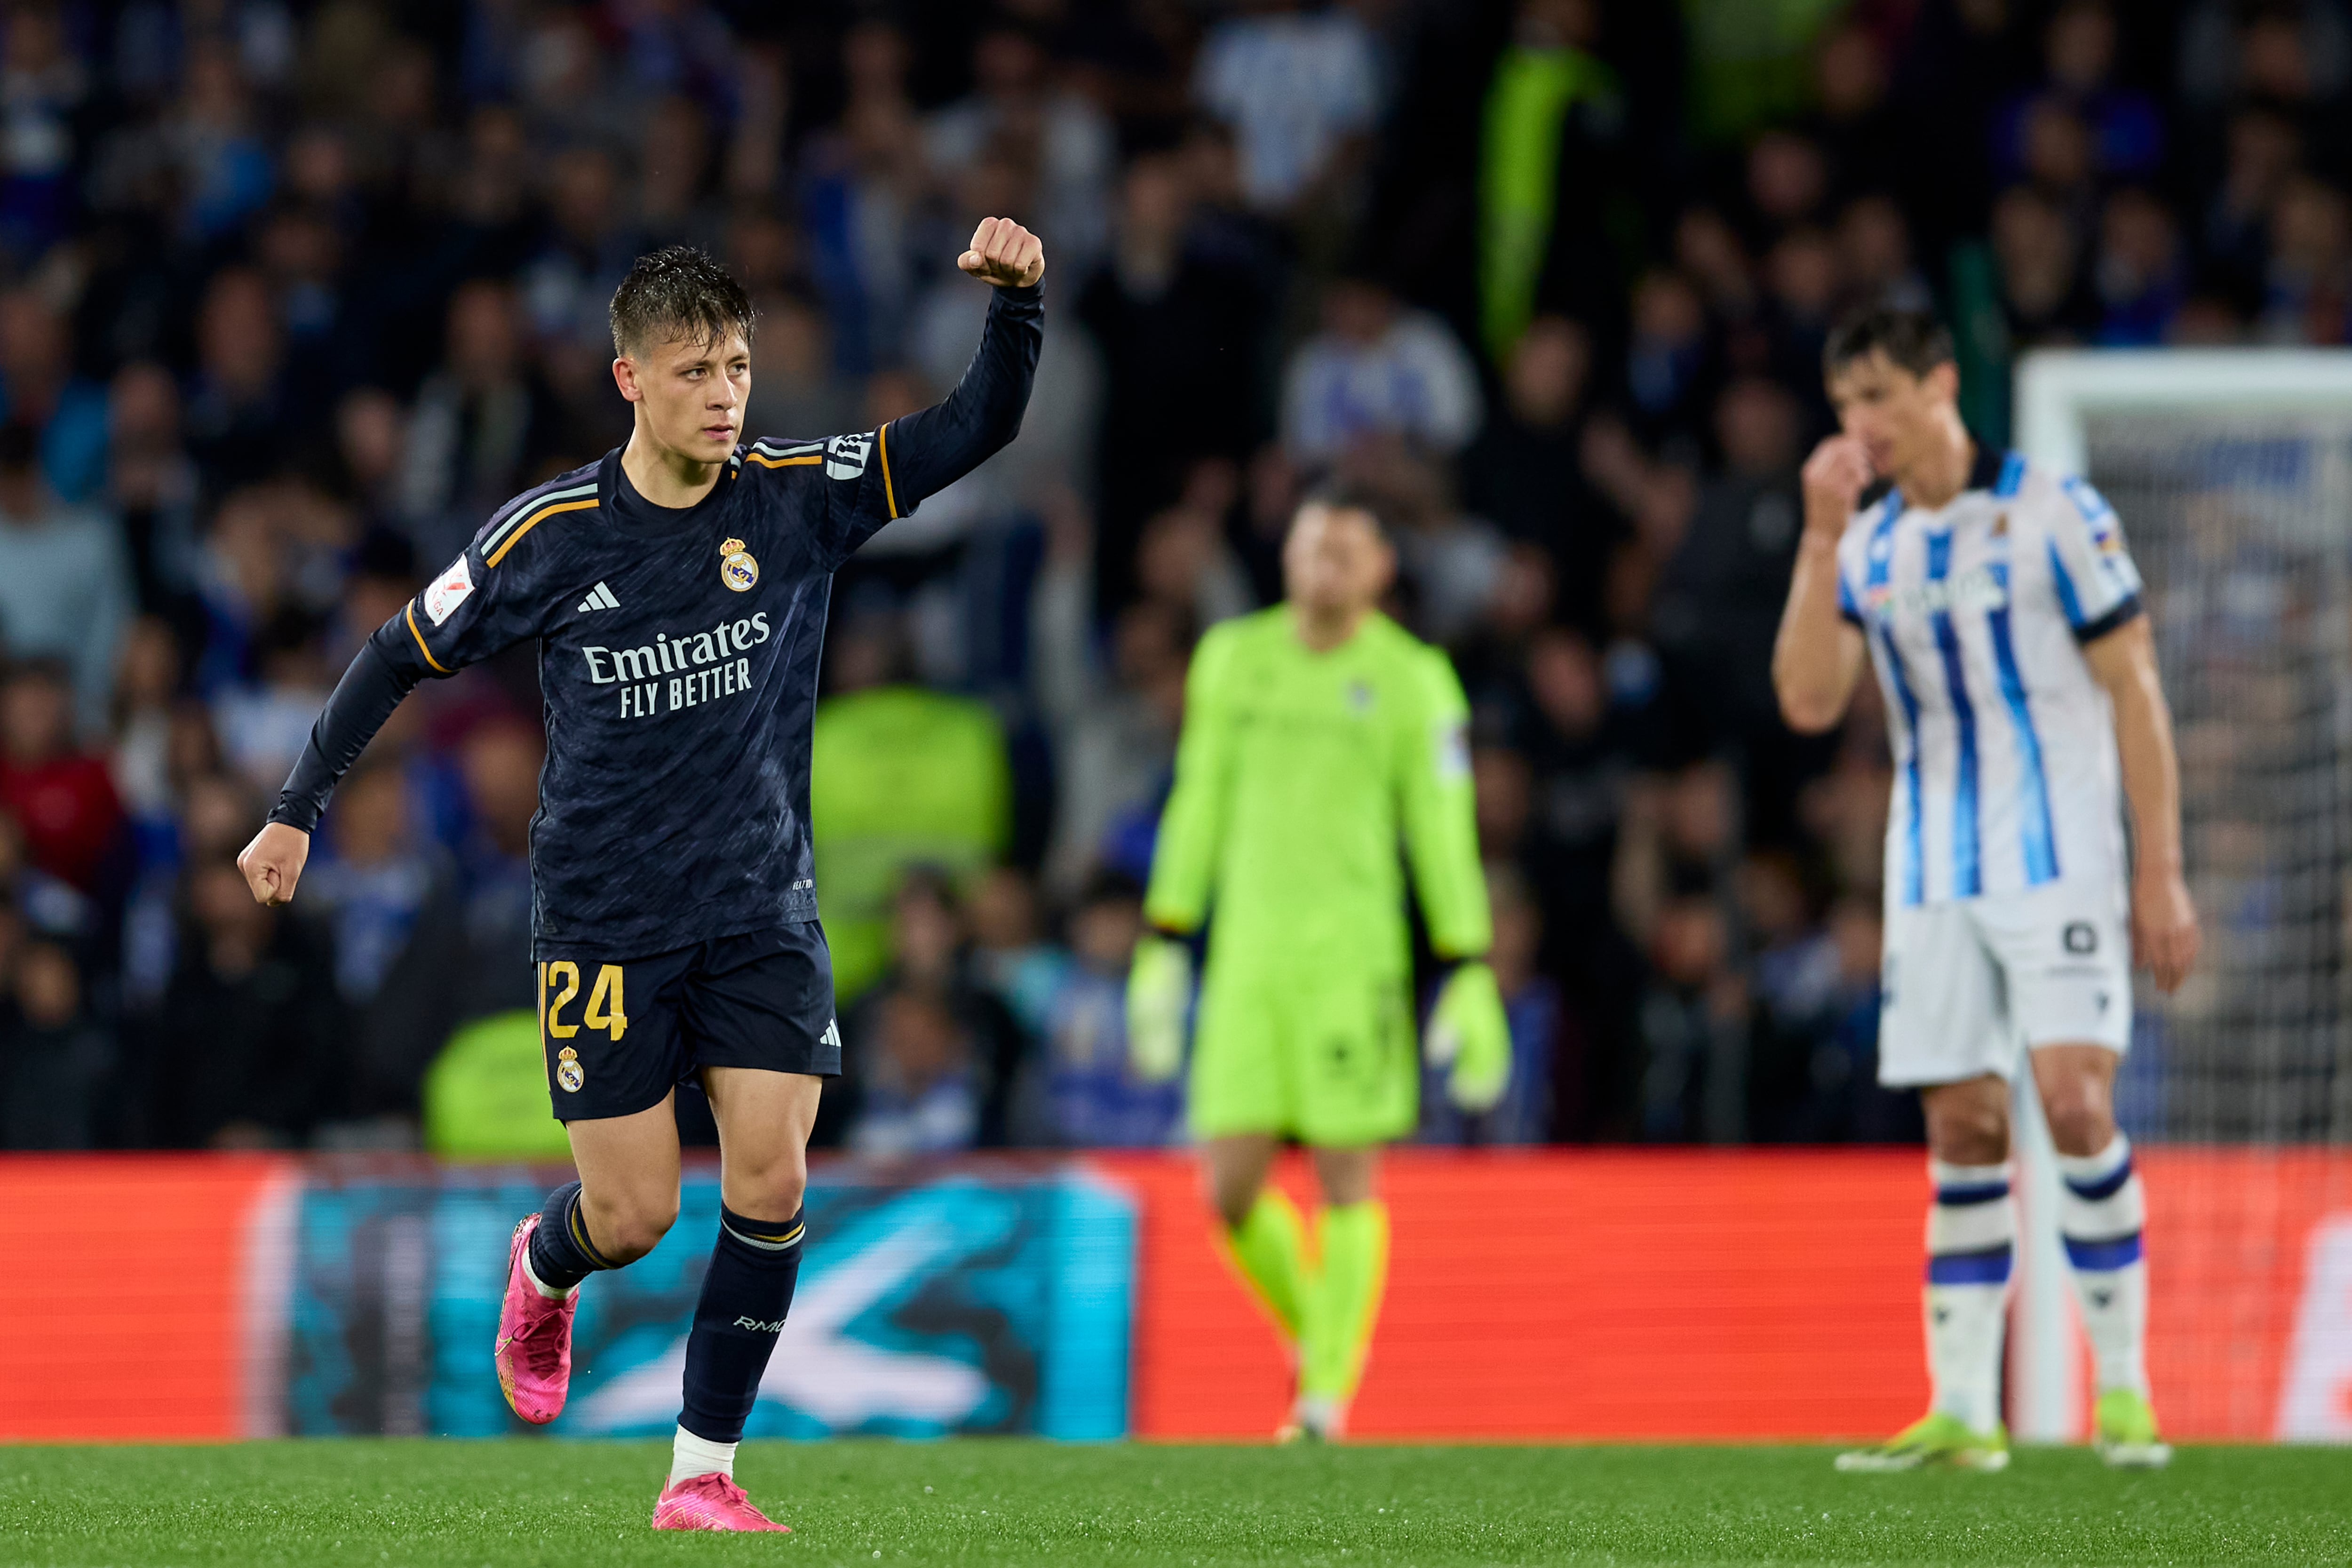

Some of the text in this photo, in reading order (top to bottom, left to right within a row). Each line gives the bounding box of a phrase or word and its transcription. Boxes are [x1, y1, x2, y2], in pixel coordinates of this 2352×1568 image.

[582, 612, 770, 684] Emirates
[620, 657, 752, 718] FLY BETTER
[548, 961, 628, 1041] 24
